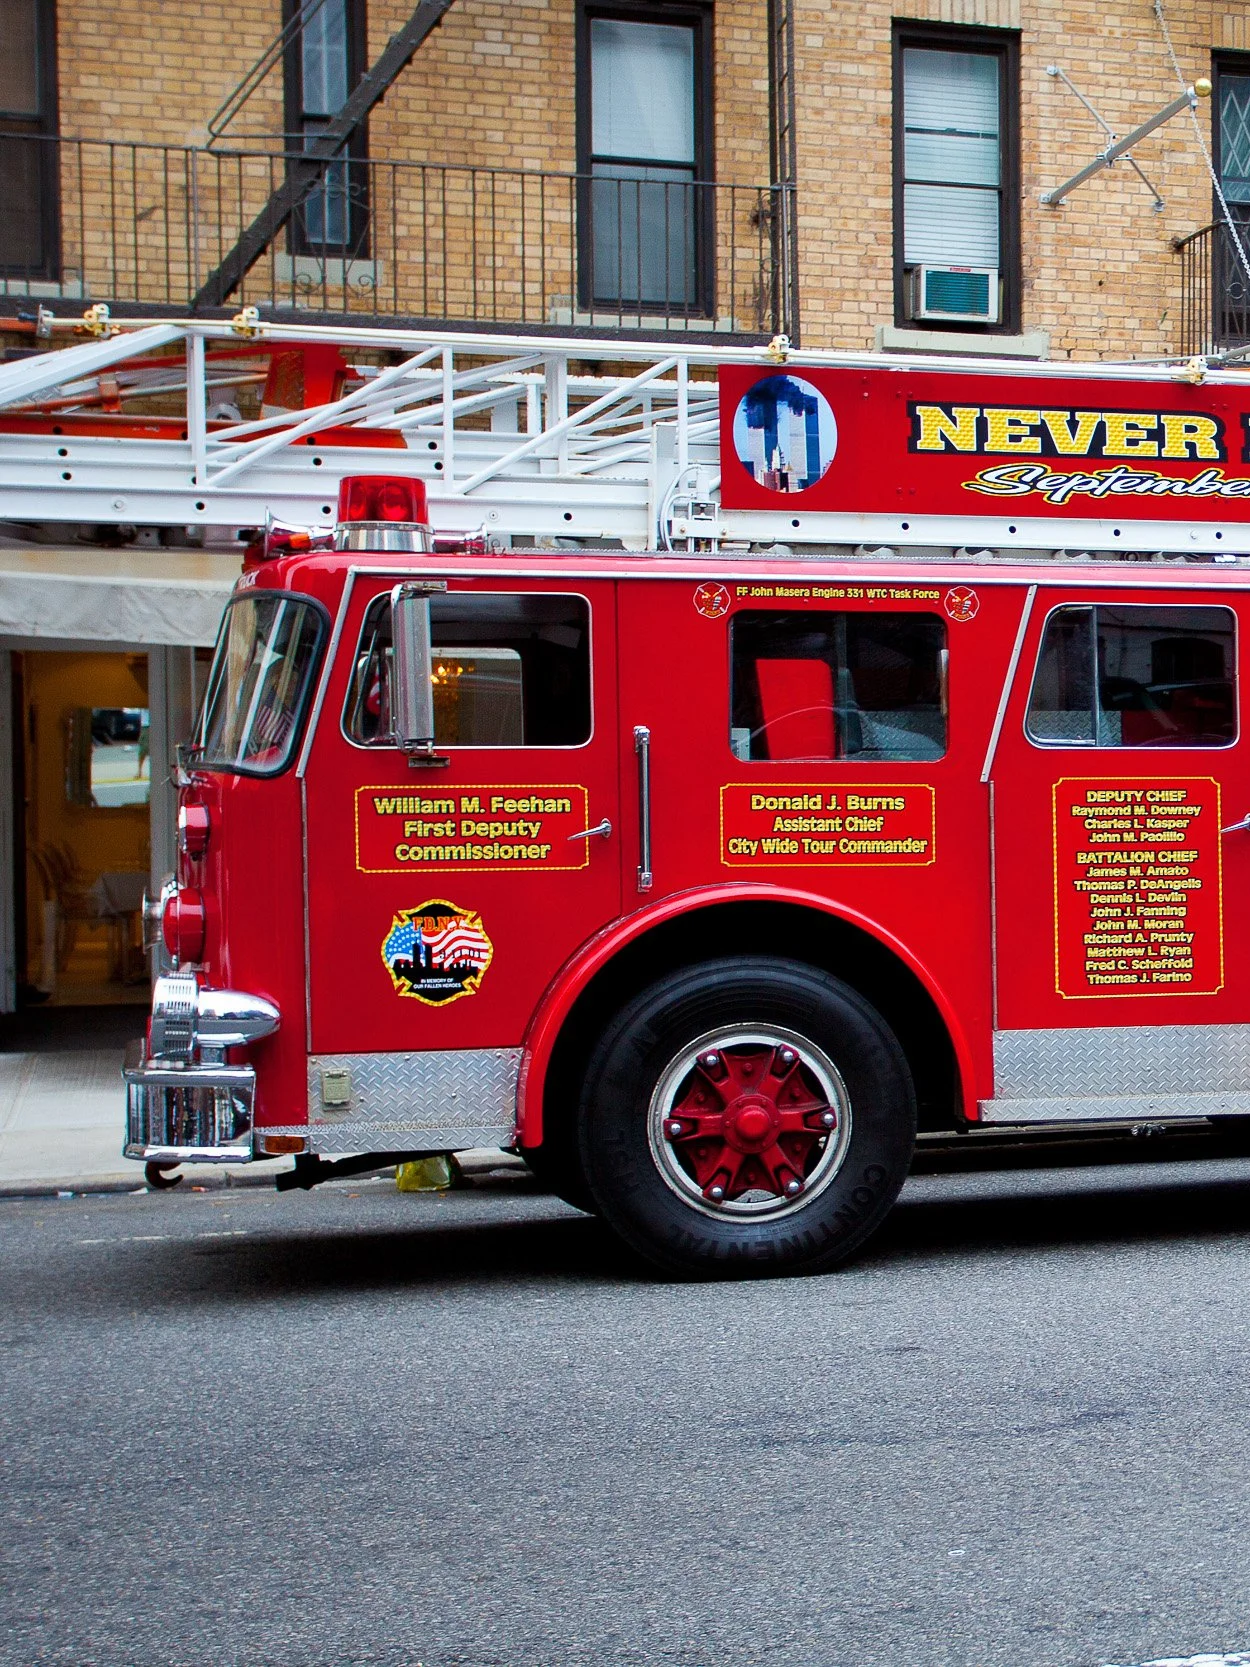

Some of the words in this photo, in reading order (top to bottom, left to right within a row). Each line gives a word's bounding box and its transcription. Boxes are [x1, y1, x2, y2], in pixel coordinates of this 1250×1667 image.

[914, 405, 1221, 459] NEVER
[736, 587, 748, 596] FF
[750, 587, 773, 596] John
[776, 587, 810, 597] Masera
[812, 588, 845, 599] Engine
[846, 588, 863, 597] 331
[866, 588, 887, 598] WTC
[888, 589, 911, 598] Task
[912, 589, 940, 599] Force
[1086, 791, 1143, 802] DEPUTY
[1146, 790, 1187, 802] CHIEF
[373, 797, 454, 814] William
[460, 797, 485, 813] M.
[490, 796, 571, 813] Feehan
[751, 795, 821, 810] Donald
[826, 795, 841, 810] J.
[846, 795, 905, 810] Burns
[1072, 805, 1131, 817] Raymond
[1134, 805, 1148, 815] M.
[1150, 805, 1201, 817] Downey
[404, 821, 455, 837] First
[460, 820, 541, 840] Deputy
[773, 817, 842, 832] Assistant
[844, 817, 884, 832] Chief
[1084, 819, 1131, 829] Charles
[1134, 819, 1144, 829] L.
[1146, 818, 1190, 830] Kasper
[1089, 832, 1120, 842] John
[1122, 832, 1137, 842] M.
[395, 843, 551, 861] Commissioner
[728, 838, 758, 856] City
[762, 838, 798, 853] Wide
[802, 838, 836, 853] Tour
[838, 838, 927, 853] Commander
[1076, 852, 1154, 863] BATTALION
[1158, 851, 1198, 862] CHIEF
[1087, 866, 1127, 877] James
[1130, 866, 1143, 876] M.
[1146, 865, 1189, 876] Amato
[1074, 880, 1124, 890] Thomas
[1126, 880, 1137, 890] P.
[1140, 879, 1202, 891] DeAngelis
[1090, 893, 1133, 903] Dennis
[1136, 893, 1145, 903] L.
[1148, 892, 1187, 902] Devlin
[1090, 907, 1121, 917] John
[1124, 907, 1133, 916] J.
[1136, 906, 1187, 918] Fanning
[1093, 920, 1124, 930] John
[1126, 920, 1141, 930] M.
[1144, 919, 1184, 929] Moran
[1084, 933, 1132, 944] Richard
[1134, 933, 1147, 943] A.
[1150, 932, 1194, 944] Prunty
[1087, 947, 1145, 957] Matthew
[1148, 946, 1157, 956] L.
[1160, 946, 1191, 958] Ryan
[1085, 960, 1115, 971] Fred
[1118, 960, 1128, 970] C.
[1132, 958, 1193, 970] Scheffold
[1087, 973, 1137, 984] Thomas
[1140, 973, 1149, 983] J.
[1152, 972, 1192, 983] Farino
